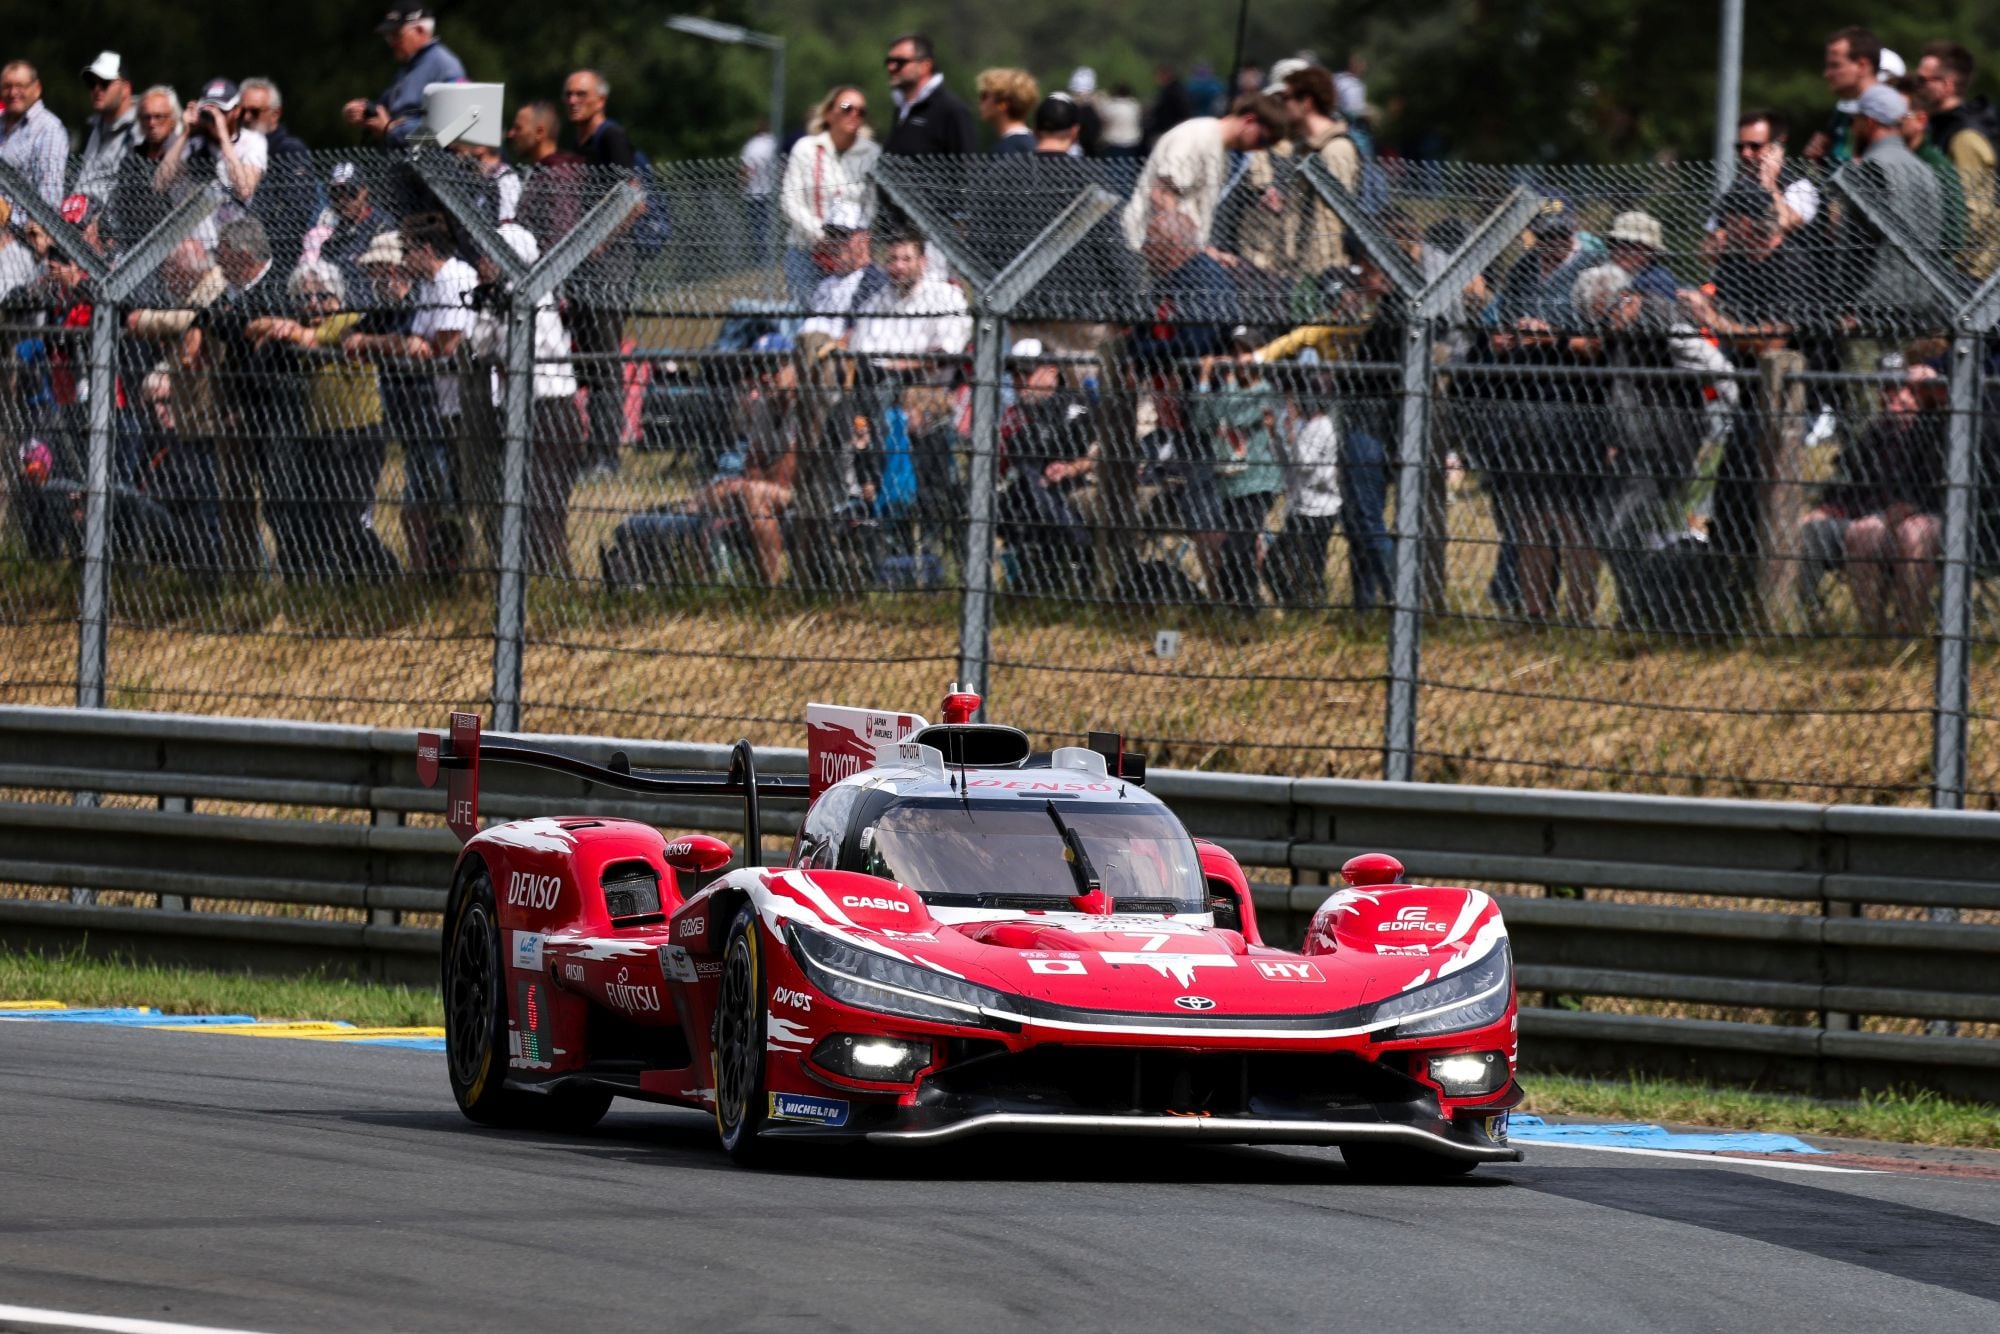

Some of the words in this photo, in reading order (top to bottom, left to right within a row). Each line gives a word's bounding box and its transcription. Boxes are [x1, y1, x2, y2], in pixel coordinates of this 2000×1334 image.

[874, 717, 887, 726] JAPAN
[874, 729, 893, 739] AIRLINES
[900, 744, 919, 760] TOYOTA
[820, 752, 861, 784] TOYOTA
[968, 779, 1112, 792] DENSO
[450, 799, 473, 825] JFE
[664, 843, 692, 857] DENSO
[508, 871, 561, 911] DENSO
[842, 895, 910, 913] CASIO
[680, 916, 705, 938] RAYS
[1377, 921, 1447, 933] EDIFICE
[1123, 932, 1171, 951] 7
[565, 963, 585, 982] AISIN
[1258, 962, 1310, 978] HY
[605, 982, 661, 1016] FUJITSU
[772, 986, 813, 1012] ADVICS
[785, 1102, 840, 1119] MICHELIN
